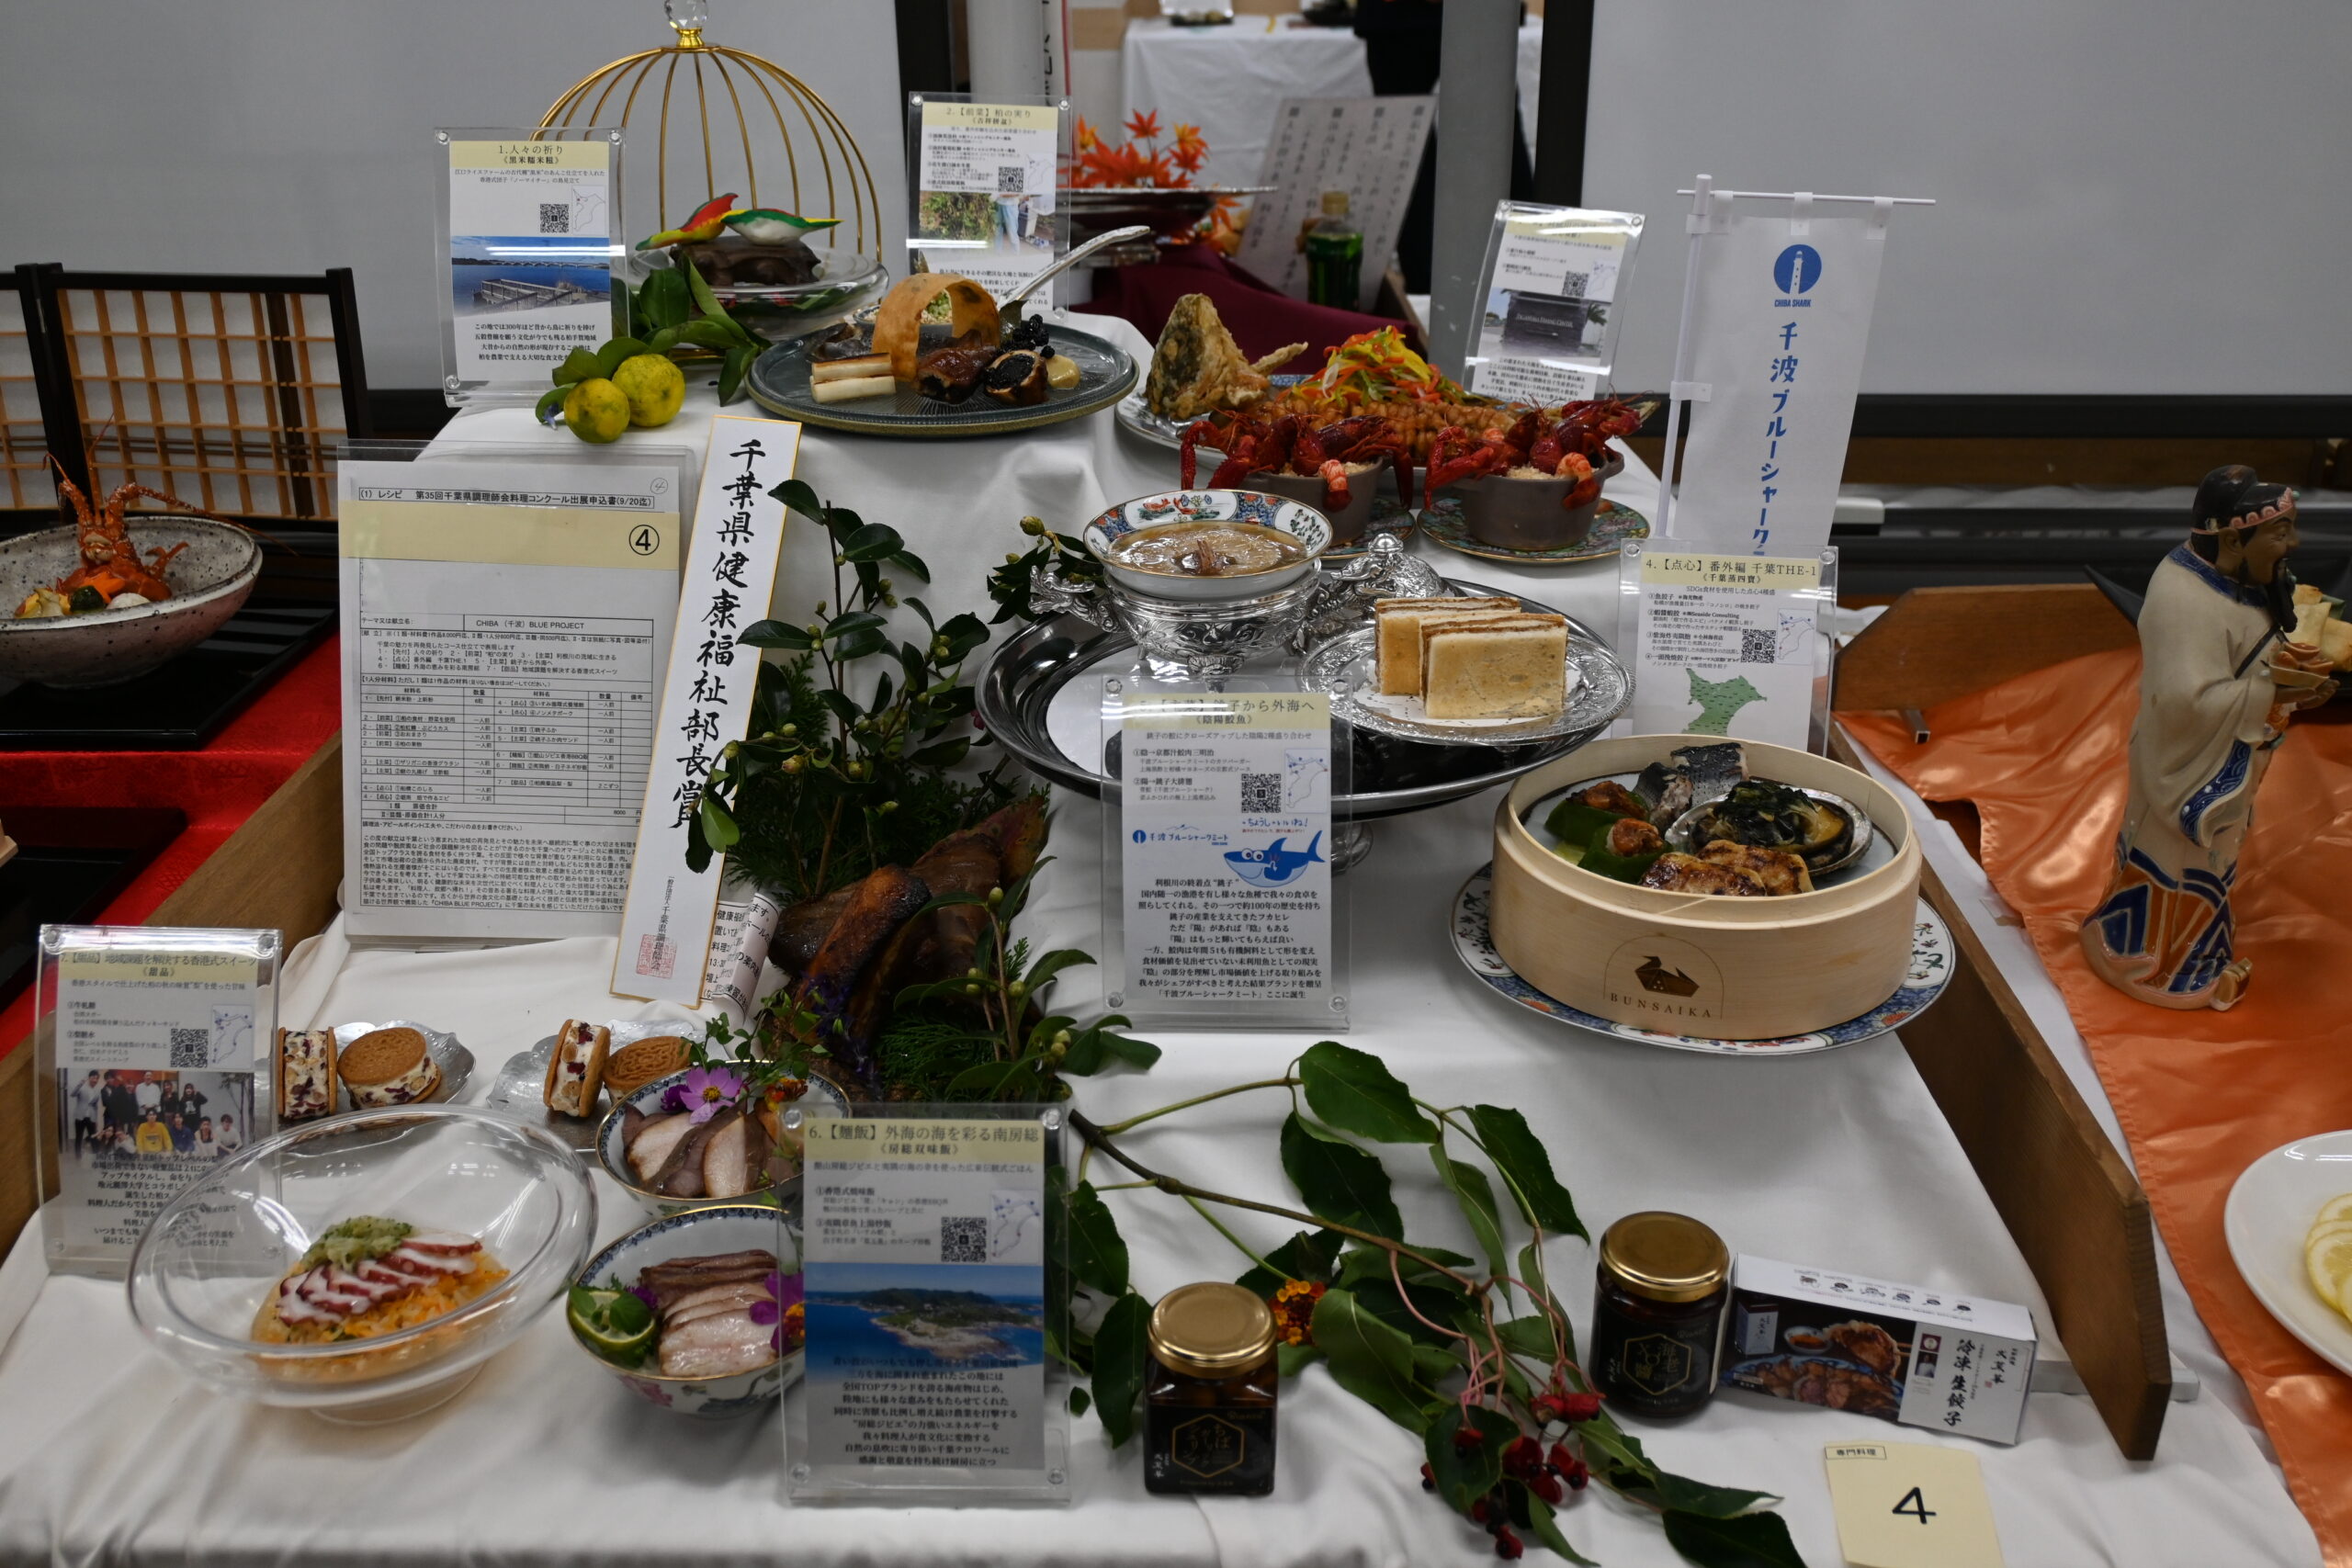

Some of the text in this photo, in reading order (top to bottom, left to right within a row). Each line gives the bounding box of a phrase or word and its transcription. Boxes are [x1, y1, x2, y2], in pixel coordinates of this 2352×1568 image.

[499, 145, 563, 155] 1.人々の祈り
[1775, 299, 1811, 308] CHIBA SHARK
[378, 490, 403, 499] レシピ
[529, 621, 548, 629] BLUE
[549, 622, 584, 630] PROJECT
[672, 438, 766, 829] 千葉県健康福祉部長賞
[1170, 913, 1289, 921] 銚子の産業を支えてきたフカヒレ
[1610, 992, 1712, 1019] BUNSAIKA
[1892, 1486, 1937, 1525] 4
